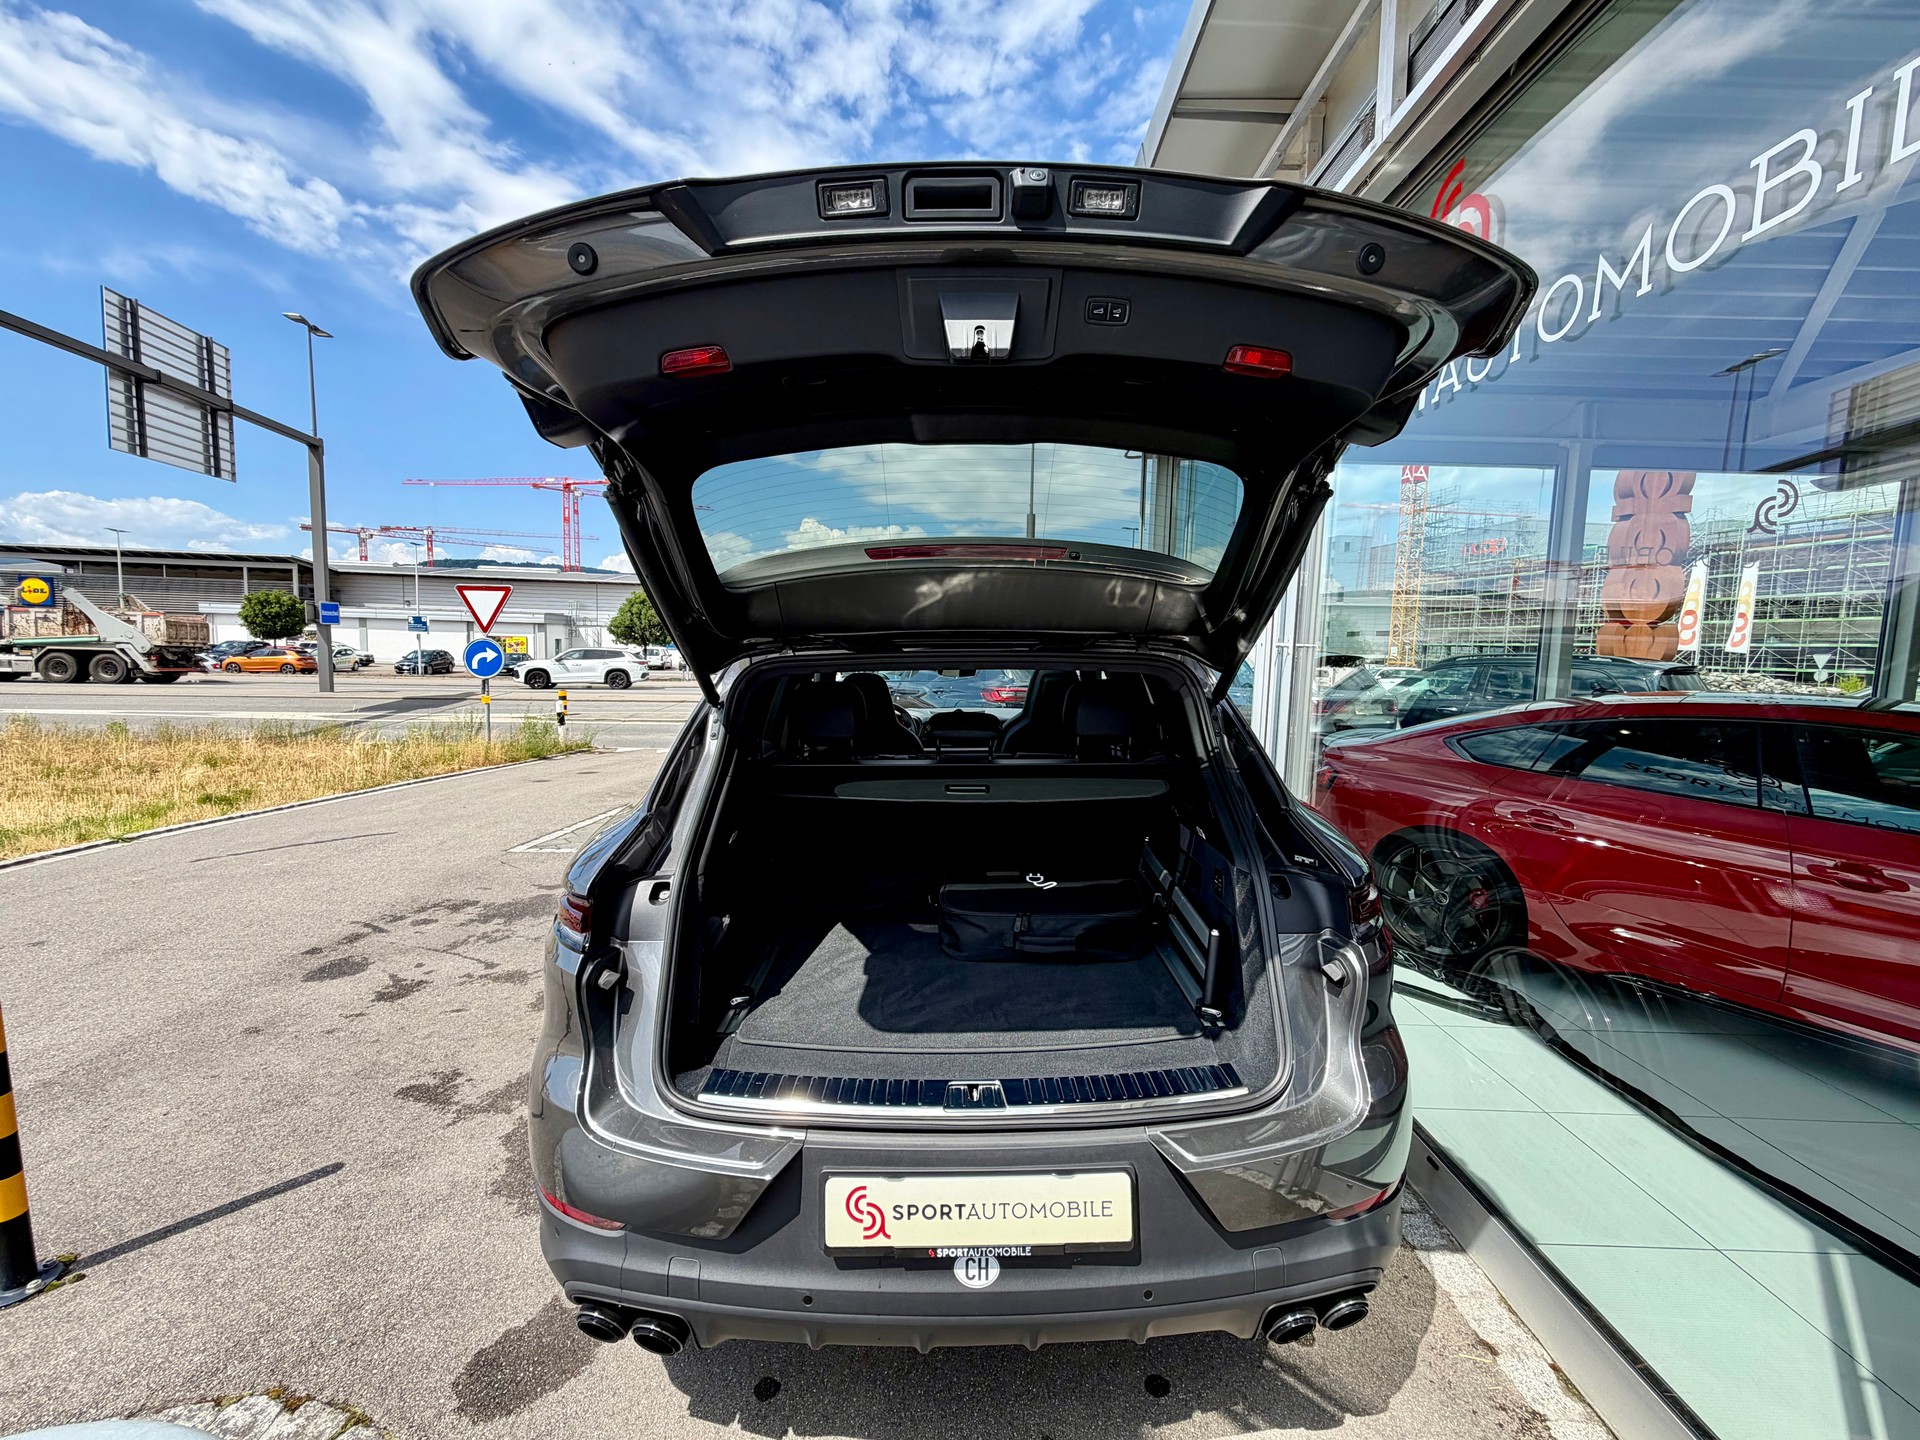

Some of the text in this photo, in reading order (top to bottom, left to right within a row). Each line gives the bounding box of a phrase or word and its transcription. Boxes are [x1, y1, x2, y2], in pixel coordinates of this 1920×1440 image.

[892, 1200, 1113, 1221] SPORTAUTOMOBILE
[936, 1247, 1032, 1258] SPORTAUTOMOBILE
[965, 1257, 989, 1281] CH
